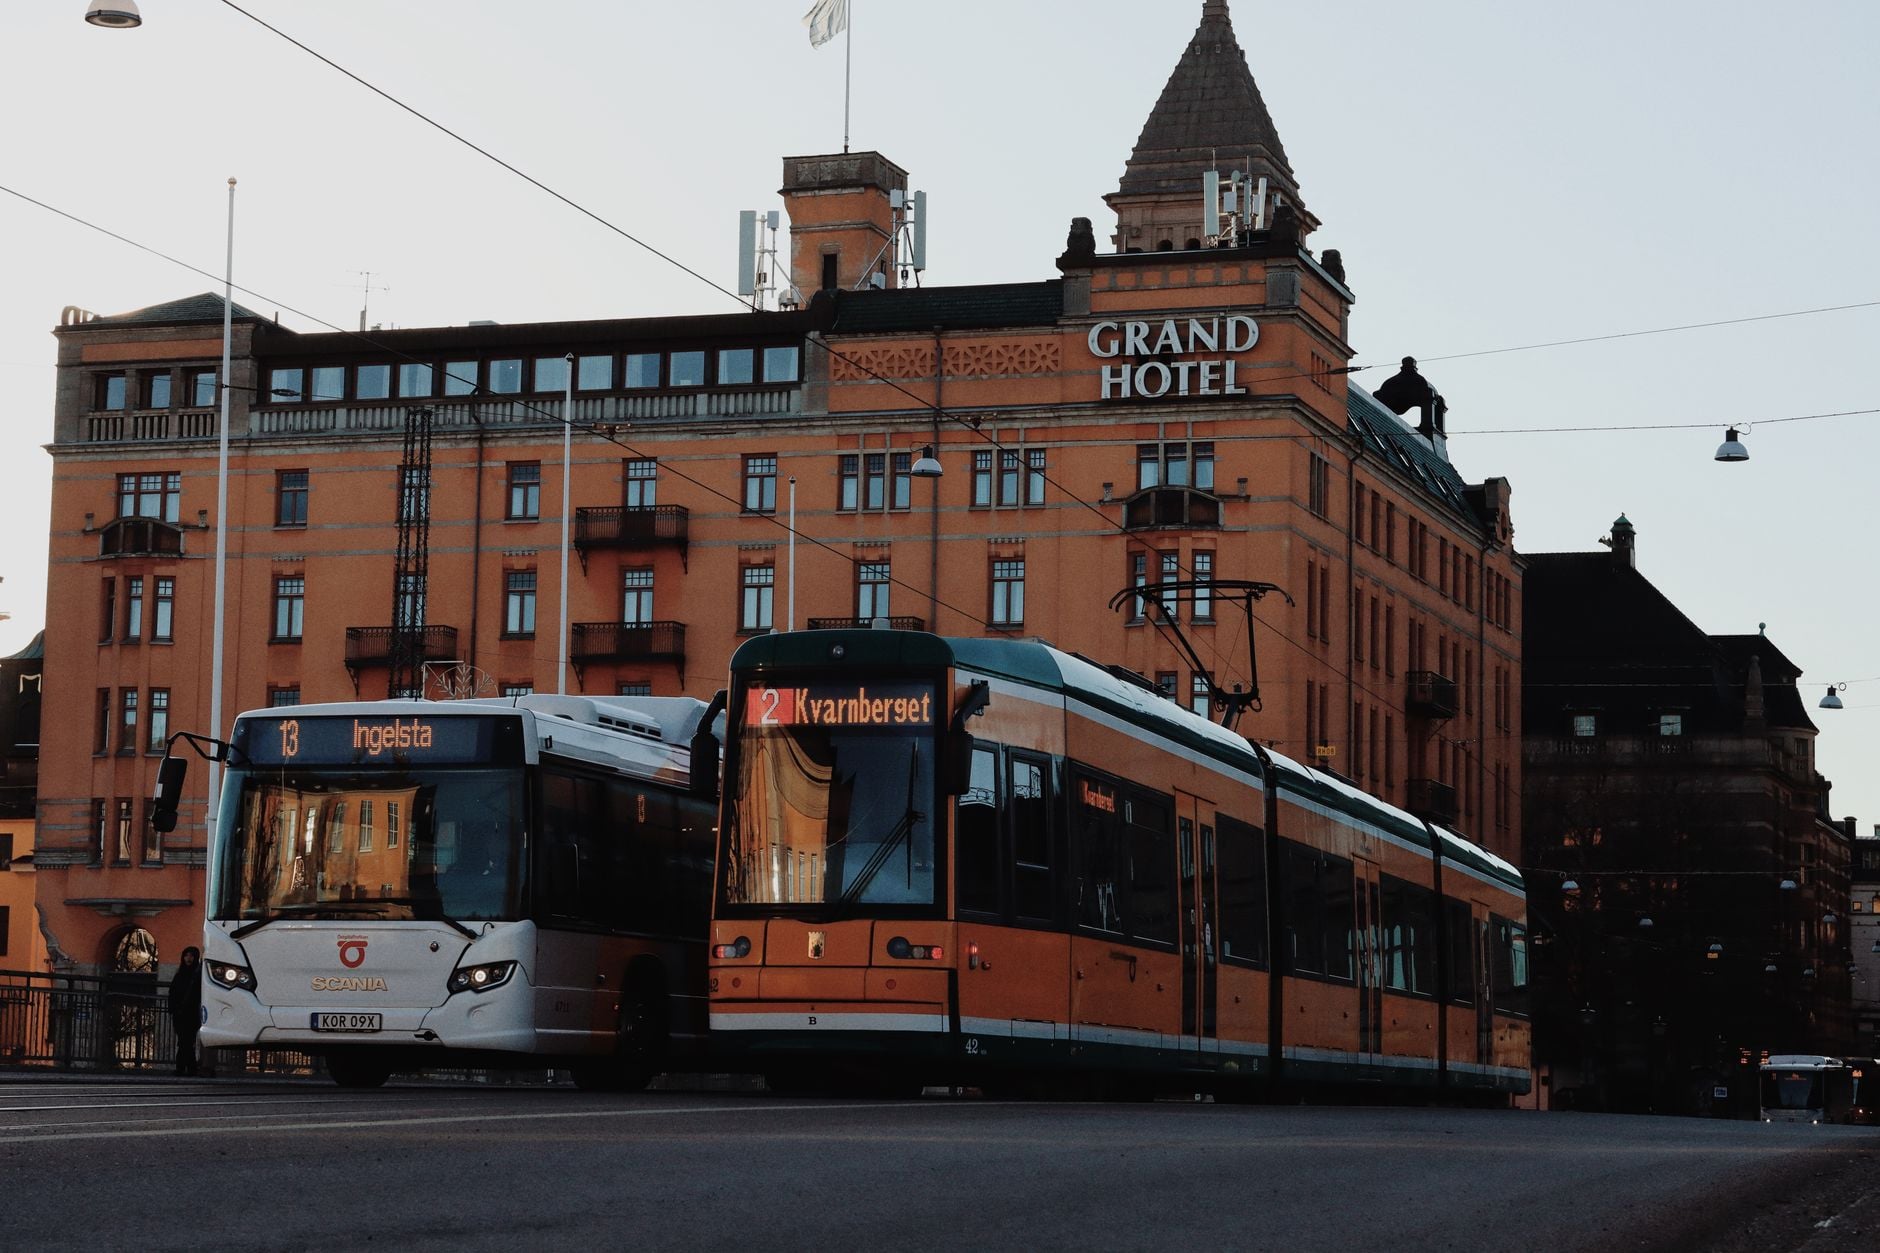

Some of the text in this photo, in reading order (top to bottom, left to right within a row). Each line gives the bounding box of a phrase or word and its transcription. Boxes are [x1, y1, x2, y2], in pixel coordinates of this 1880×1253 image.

[1088, 315, 1260, 358] GRAND
[1100, 359, 1247, 399] HOTEL
[760, 687, 930, 725] 2 Kvarnberget
[279, 719, 299, 757] 13
[353, 718, 432, 756] Ingelsta
[311, 976, 388, 991] SCANIA
[322, 1015, 375, 1028] KOR 09X
[808, 1016, 817, 1026] B
[965, 1038, 979, 1055] 42
